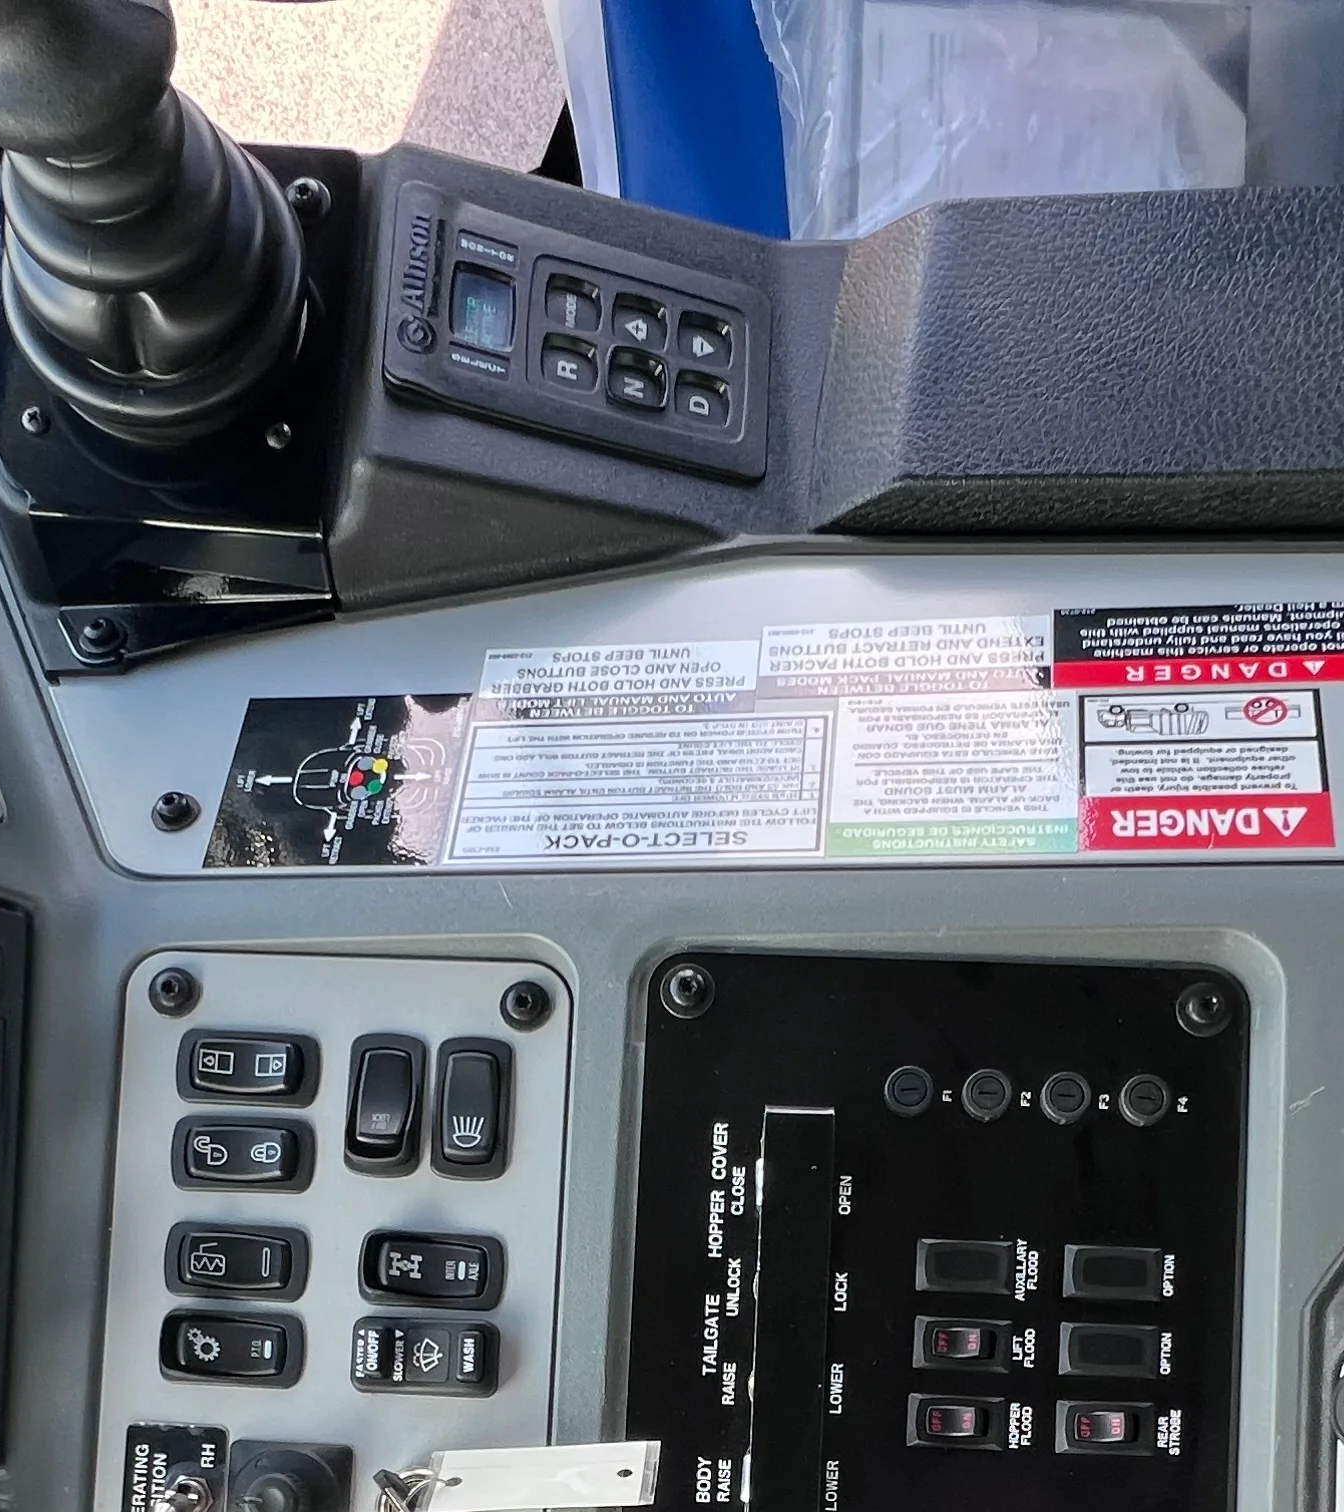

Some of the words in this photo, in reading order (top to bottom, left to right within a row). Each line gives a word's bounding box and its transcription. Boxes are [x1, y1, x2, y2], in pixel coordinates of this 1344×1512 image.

[401, 215, 431, 315] Allison
[564, 294, 579, 329] MODE
[557, 361, 579, 381] R
[623, 377, 646, 399] N
[689, 396, 710, 416] D
[552, 651, 601, 663] STOPS
[604, 649, 644, 661] BEEP
[648, 648, 691, 660] UNTIL
[1093, 648, 1154, 658] machine
[1157, 647, 1183, 657] this
[1187, 644, 1239, 655] service
[1243, 644, 1259, 653] or
[1263, 641, 1318, 654] operate
[1321, 642, 1344, 652] not
[517, 666, 586, 679] BUTTONS
[588, 664, 640, 676] CLOSE
[643, 663, 677, 675] AND
[680, 661, 721, 674] OPEN
[1125, 662, 1287, 681] DANGER
[491, 682, 563, 695] GRABBER
[568, 680, 609, 692] BOTH
[612, 679, 655, 691] HOLD
[659, 677, 691, 690] AND
[694, 675, 745, 688] PRESS
[555, 696, 585, 708] LIFT
[588, 695, 654, 707] MANUAL
[657, 694, 691, 706] AND
[693, 692, 737, 704] AUTO
[529, 707, 604, 719] BETWEEN
[608, 704, 671, 716] TOGGLE
[674, 703, 696, 715] TO
[1110, 807, 1260, 836] DANGER
[543, 830, 748, 850] SELECT-O-PACK
[943, 1090, 953, 1102] F1
[1021, 1091, 1031, 1107] F2
[1099, 1094, 1110, 1110] F3
[1178, 1096, 1188, 1113] F4
[711, 1123, 729, 1180] COVER
[731, 1167, 746, 1216] CLOSE
[839, 1175, 853, 1215] OPEN
[708, 1190, 726, 1258] HOPPER
[468, 1262, 479, 1280] AXLE
[1015, 1239, 1028, 1301] AUXILLARY
[1027, 1250, 1039, 1290] FLOOD
[1163, 1254, 1175, 1297] OPTION
[726, 1258, 741, 1317] UNLOCK
[834, 1272, 848, 1312] LOCK
[702, 1294, 720, 1376] TAILGATE
[937, 1332, 948, 1353] OFF
[967, 1334, 978, 1350] ON
[366, 1330, 380, 1371] ON/OFF
[463, 1338, 474, 1372] WASH
[1013, 1336, 1024, 1360] LIFT
[1024, 1328, 1036, 1368] FLOOD
[1160, 1332, 1172, 1374] OPTION
[393, 1340, 404, 1381] SLOWER
[722, 1362, 737, 1405] RAISE
[829, 1363, 844, 1414] LOWER
[931, 1410, 942, 1432] OFF
[962, 1413, 972, 1429] ON
[1009, 1403, 1021, 1449] HOPPER
[1021, 1406, 1033, 1446] FLOOD
[1080, 1417, 1091, 1437] OFF
[1111, 1418, 1121, 1434] ON
[1157, 1416, 1169, 1448] REAR
[1169, 1409, 1181, 1456] STROBE
[201, 1443, 215, 1468] RH
[696, 1456, 711, 1503] BODY
[717, 1459, 732, 1503] RAISE
[825, 1460, 839, 1511] LOWER
